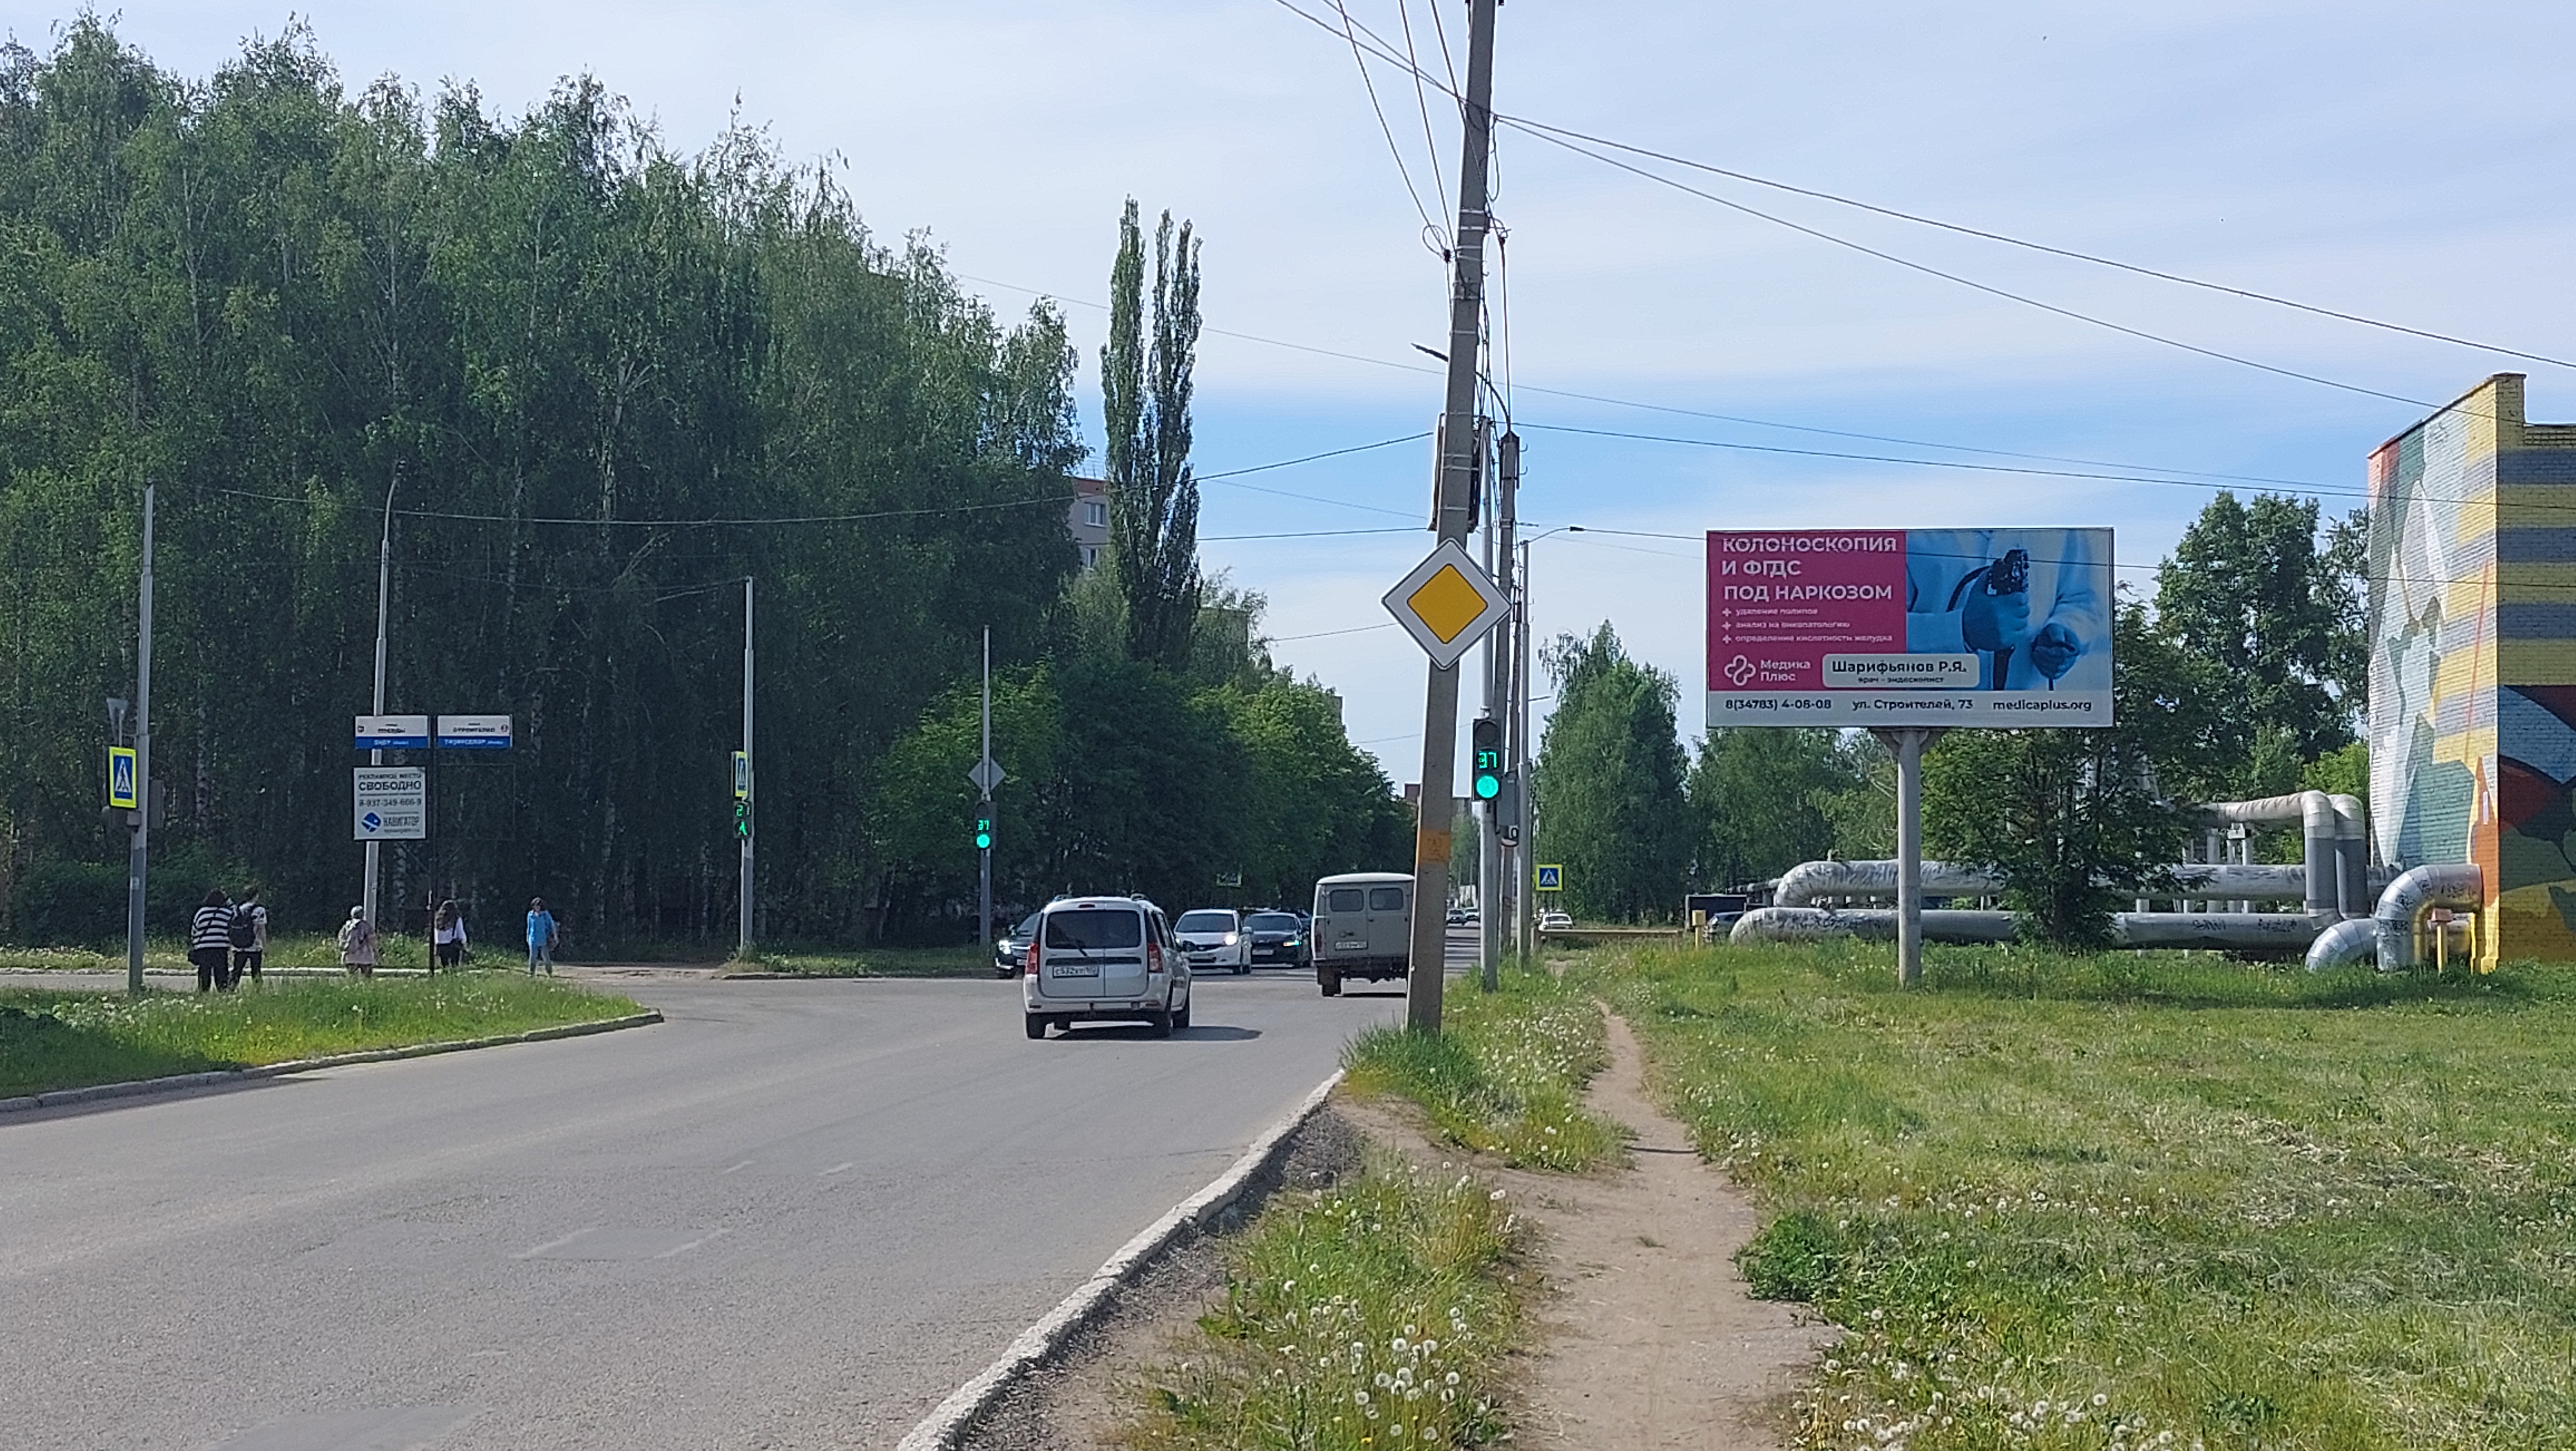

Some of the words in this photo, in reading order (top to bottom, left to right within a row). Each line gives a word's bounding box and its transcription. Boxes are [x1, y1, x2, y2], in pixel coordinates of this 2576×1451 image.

[1723, 537, 1896, 553] КОЛОНОСКОПИЯ
[1721, 560, 1736, 575] И
[1743, 559, 1802, 580] ФГДС
[1724, 585, 1769, 602] ПОД
[1775, 585, 1892, 600] НАРКОЗОМ
[1760, 660, 1811, 670] Медика
[1832, 661, 1934, 675] Шарифьянов
[1760, 672, 1796, 681] Плюс
[1852, 702, 1871, 711] ул.
[1874, 699, 1955, 710] Строителей,
[1958, 699, 1973, 709] 73
[1993, 700, 2092, 711] medicaplus.org
[1479, 751, 1497, 768] 37
[359, 781, 422, 791] СВОБОДНО
